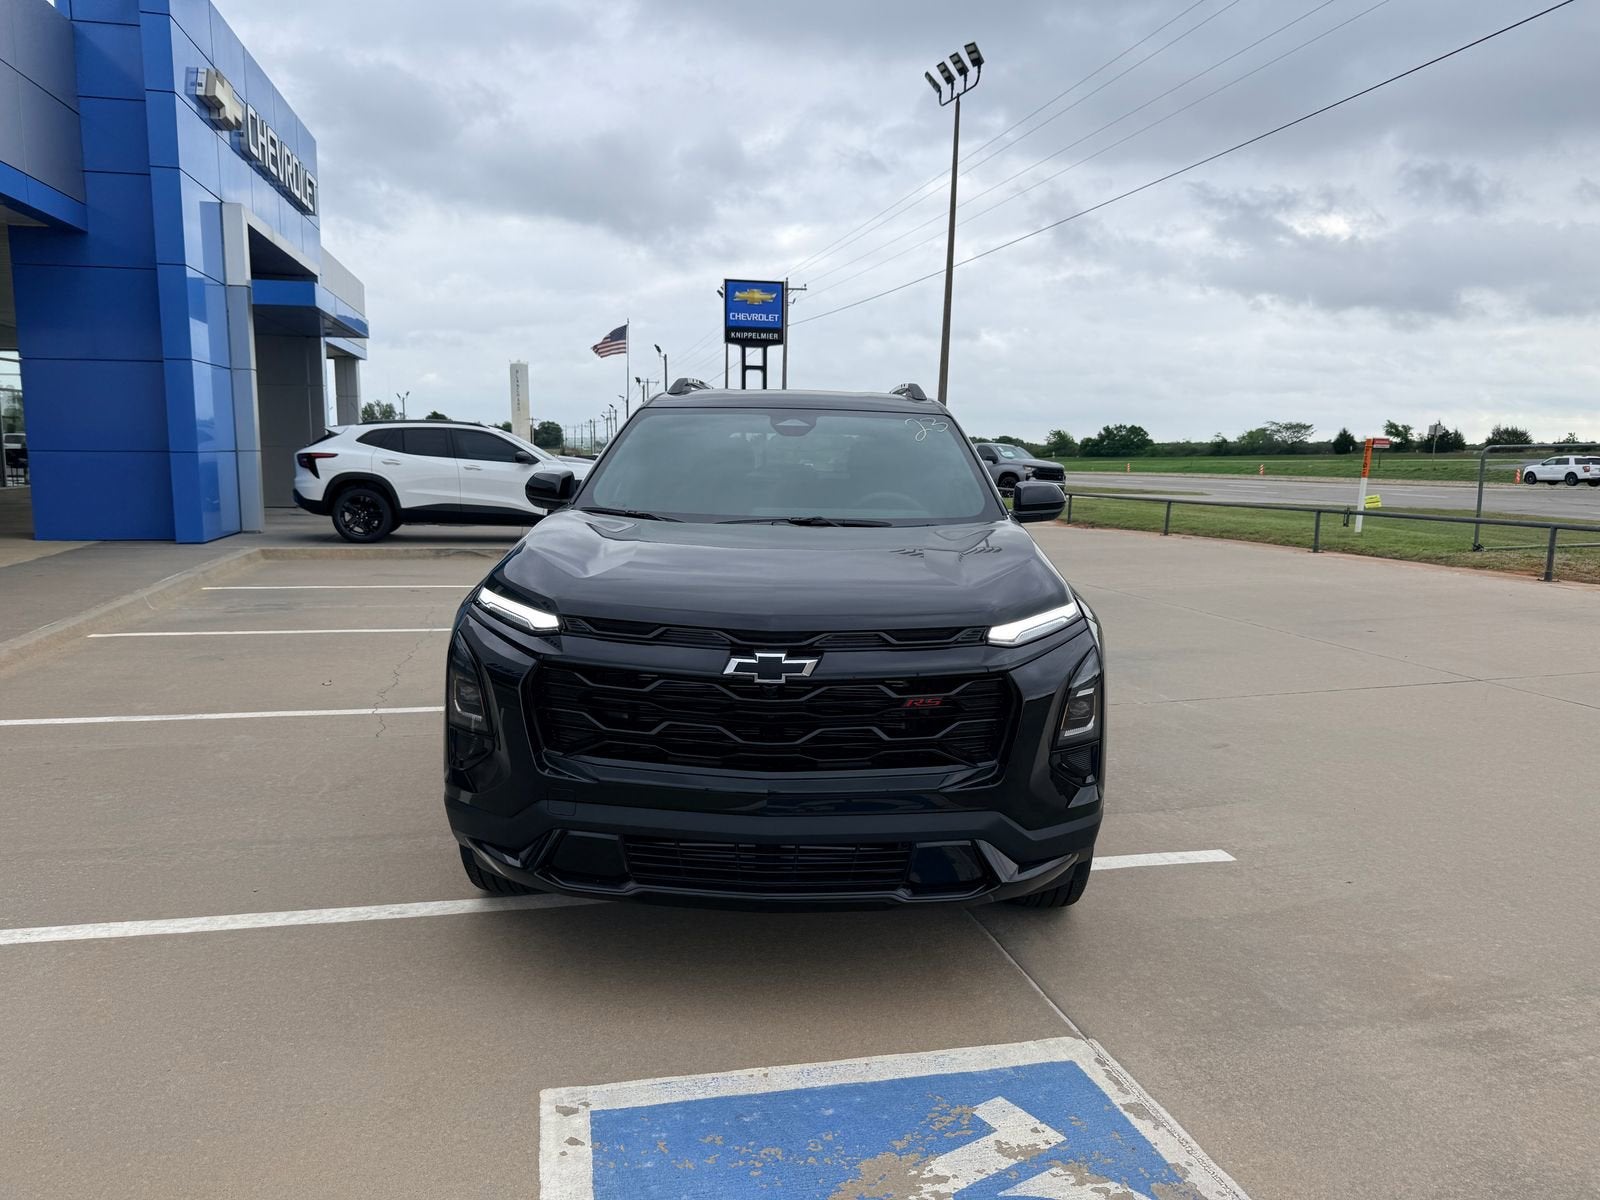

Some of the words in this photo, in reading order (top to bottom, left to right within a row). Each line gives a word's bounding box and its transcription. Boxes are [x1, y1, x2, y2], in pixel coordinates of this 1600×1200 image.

[246, 103, 317, 214] CHEVROLET
[729, 312, 779, 322] CHEVROLET
[730, 331, 779, 340] KNIPPELMIER
[902, 697, 943, 708] RS
